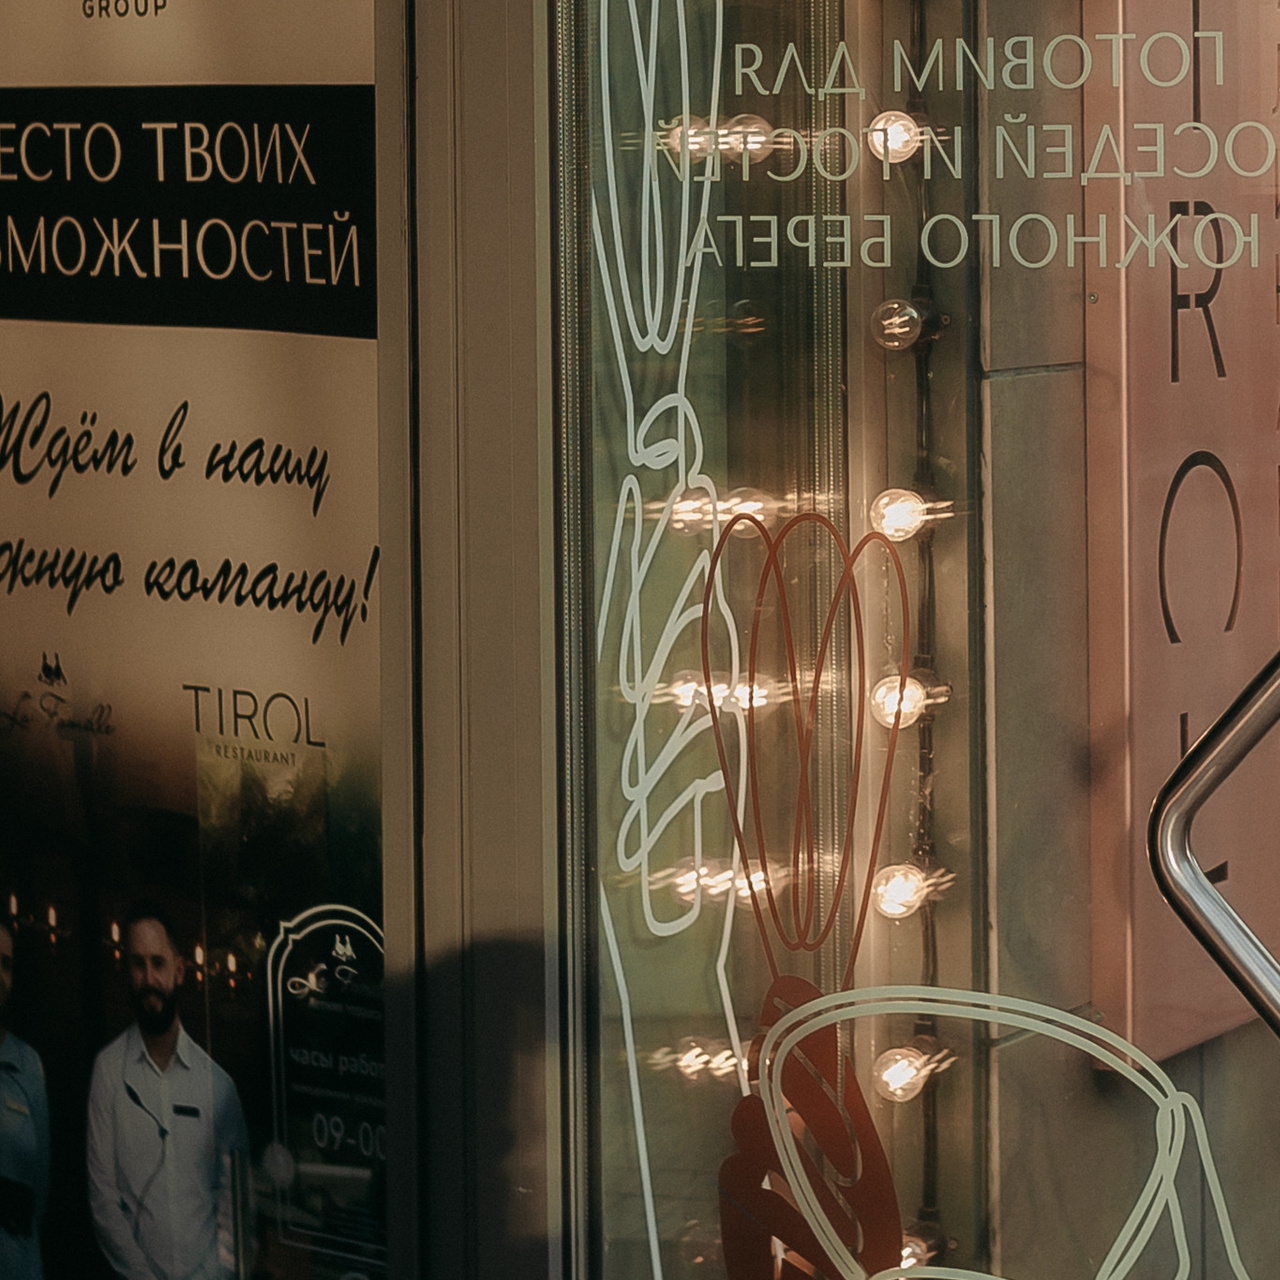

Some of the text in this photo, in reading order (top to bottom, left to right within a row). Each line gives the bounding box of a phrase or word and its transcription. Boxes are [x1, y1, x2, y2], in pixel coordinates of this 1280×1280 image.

[141, 121, 317, 185] ТВОИХ
[157, 399, 187, 481] в
[204, 437, 331, 518] нашу
[144, 544, 380, 647] команду!
[181, 683, 327, 749] TIROL
[214, 743, 298, 767] RESTAURANT
